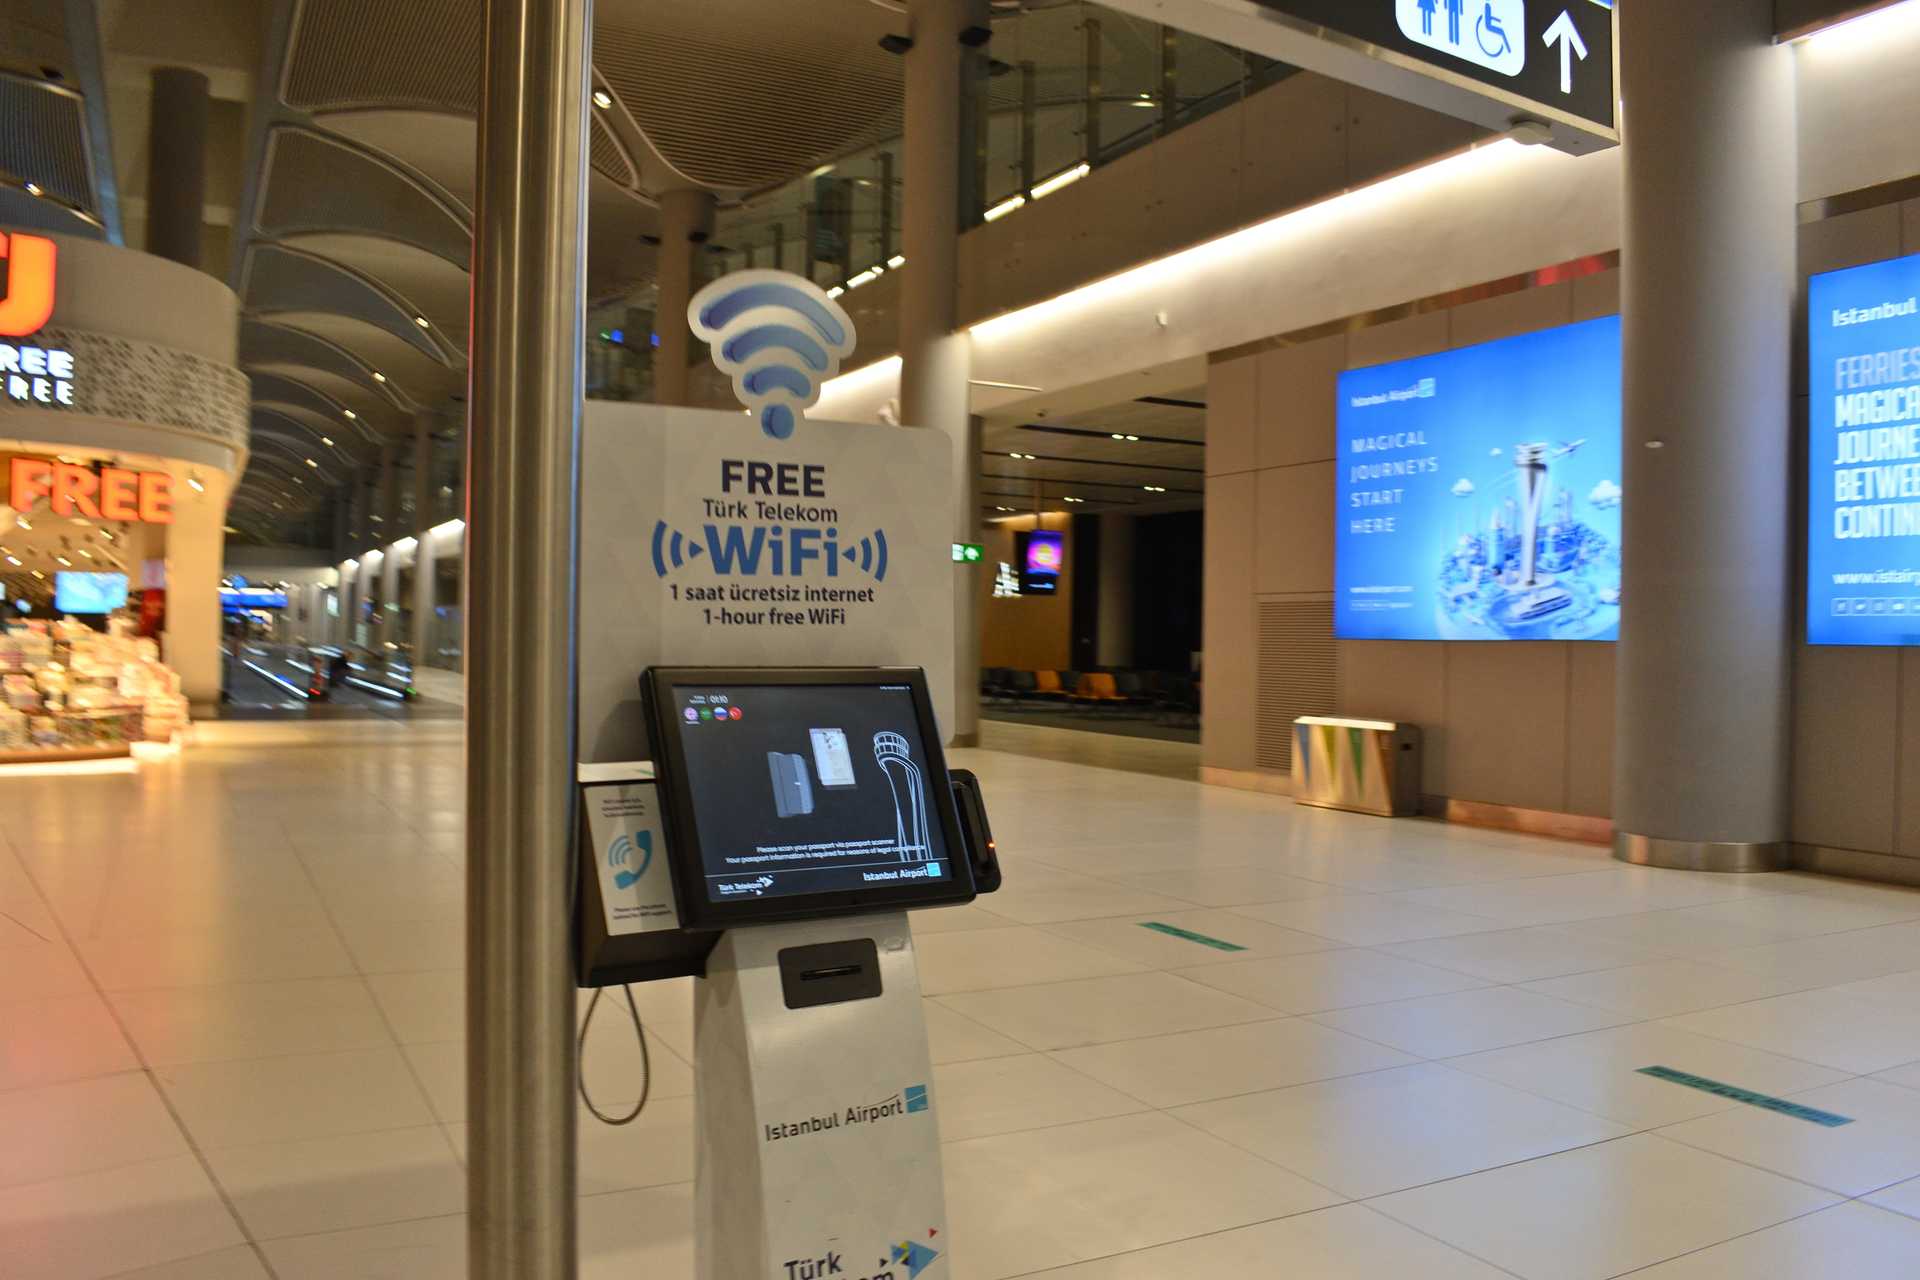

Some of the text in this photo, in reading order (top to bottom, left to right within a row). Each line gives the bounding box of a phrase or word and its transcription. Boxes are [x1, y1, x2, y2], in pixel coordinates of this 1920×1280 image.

[1832, 297, 1918, 327] Istanbul
[1351, 431, 1428, 453] MAGICAL
[721, 458, 826, 498] FREE
[1350, 456, 1439, 484] JOURNEYS
[9, 457, 176, 524] FREE
[1350, 489, 1405, 508] START
[702, 498, 838, 522] Türk Telekom
[1350, 517, 1396, 534] HERE
[703, 524, 838, 577] WiFi
[669, 583, 875, 602] 1 saat ücretsiz internet
[703, 607, 846, 625] 1-hour free WiFi
[863, 868, 928, 881] Istanbul Airport
[765, 1099, 904, 1142] Istanbul Airport
[783, 1251, 843, 1280] Türk
